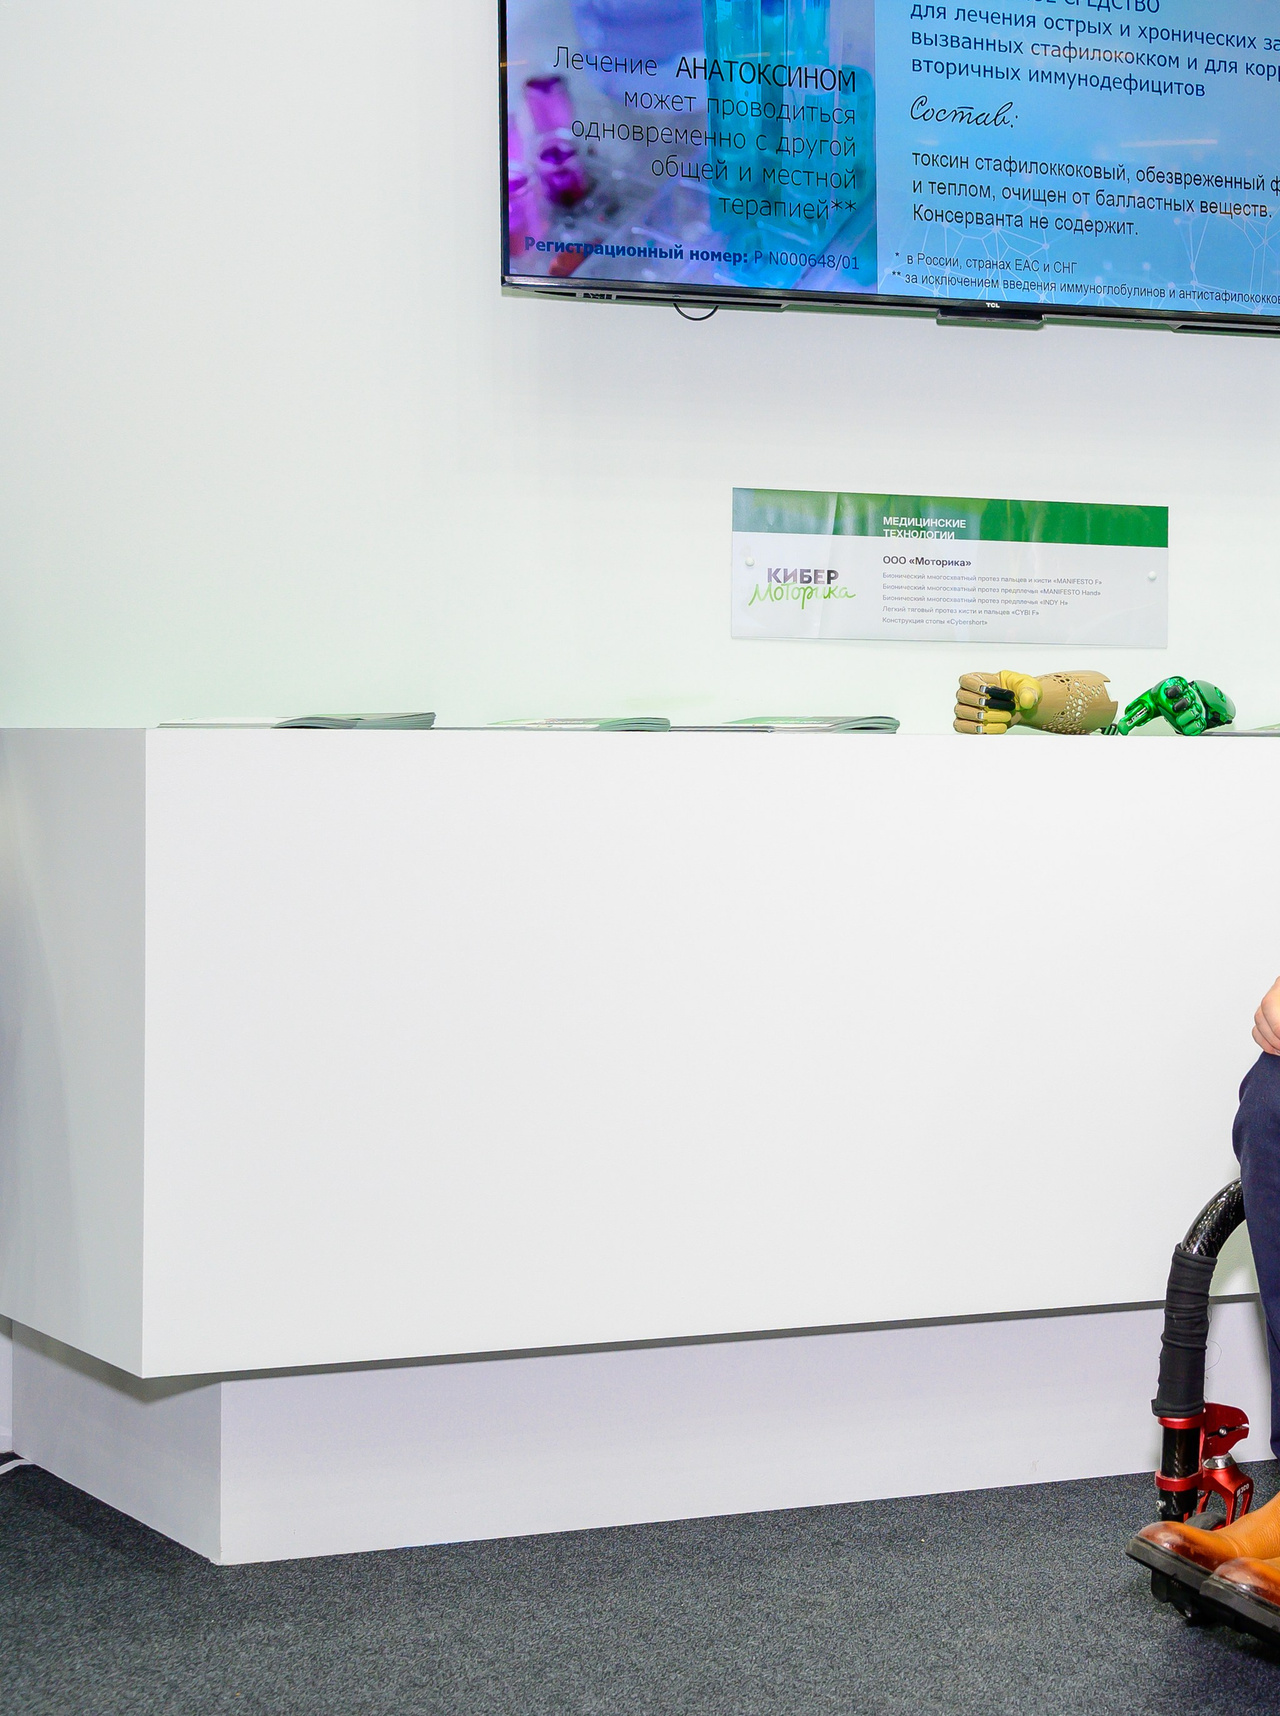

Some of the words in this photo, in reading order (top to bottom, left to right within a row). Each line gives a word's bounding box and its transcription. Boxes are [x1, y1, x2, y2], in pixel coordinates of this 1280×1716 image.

[911, 4, 946, 20] для
[954, 8, 1036, 28] лечения
[1044, 16, 1112, 37] острых
[1120, 24, 1130, 37] и
[1138, 26, 1257, 49] хронических
[553, 46, 657, 76] Лечение
[676, 56, 856, 93] АНАТОКСИНОМ
[911, 31, 1024, 54] вызванных
[1031, 41, 1179, 68] стафилококком
[1187, 57, 1198, 70] и
[1205, 58, 1238, 75] для
[912, 58, 1021, 81] вторичных
[1029, 69, 1205, 97] иммунодефицитов
[624, 91, 697, 112] может
[707, 98, 855, 125] проводиться
[910, 95, 1019, 128] Состав:
[571, 120, 746, 148] одновременно
[756, 134, 767, 151] с
[776, 136, 856, 159] другой
[651, 154, 728, 182] общей
[740, 166, 751, 183] и
[763, 167, 856, 189] местной
[912, 152, 969, 169] токсин
[975, 155, 1130, 184] стафилоккоковый,
[1136, 166, 1265, 191] обезвреженный
[912, 180, 922, 193] и
[928, 181, 996, 201] теплом,
[1001, 186, 1066, 207] очищен
[1072, 192, 1090, 205] от
[1095, 189, 1195, 213] балластных
[1200, 201, 1272, 219] веществ.
[913, 203, 1023, 229] Консерванта
[1029, 215, 1049, 229] не
[1055, 216, 1138, 237] содержит.
[524, 236, 684, 260] Регистрационный
[690, 249, 748, 265] номер:
[769, 251, 859, 270] N000648/01
[907, 255, 914, 264] в
[917, 253, 962, 269] России,
[966, 259, 1011, 271] странах
[1015, 259, 1040, 272] ЕАС
[1043, 263, 1050, 272] и
[1053, 261, 1077, 274] СНГ
[905, 274, 918, 284] за
[921, 274, 999, 288] исключением
[1003, 278, 1056, 292] введения
[1060, 283, 1165, 299] иммуноглобулинов
[1169, 288, 1176, 298] и
[883, 517, 967, 529] МЕДИЦИНСКИЕ
[883, 529, 956, 540] ТЕХНОЛОГИИ
[767, 568, 839, 584] КИБЕР
[883, 556, 907, 565] ООО
[909, 557, 972, 568] «Моторика»
